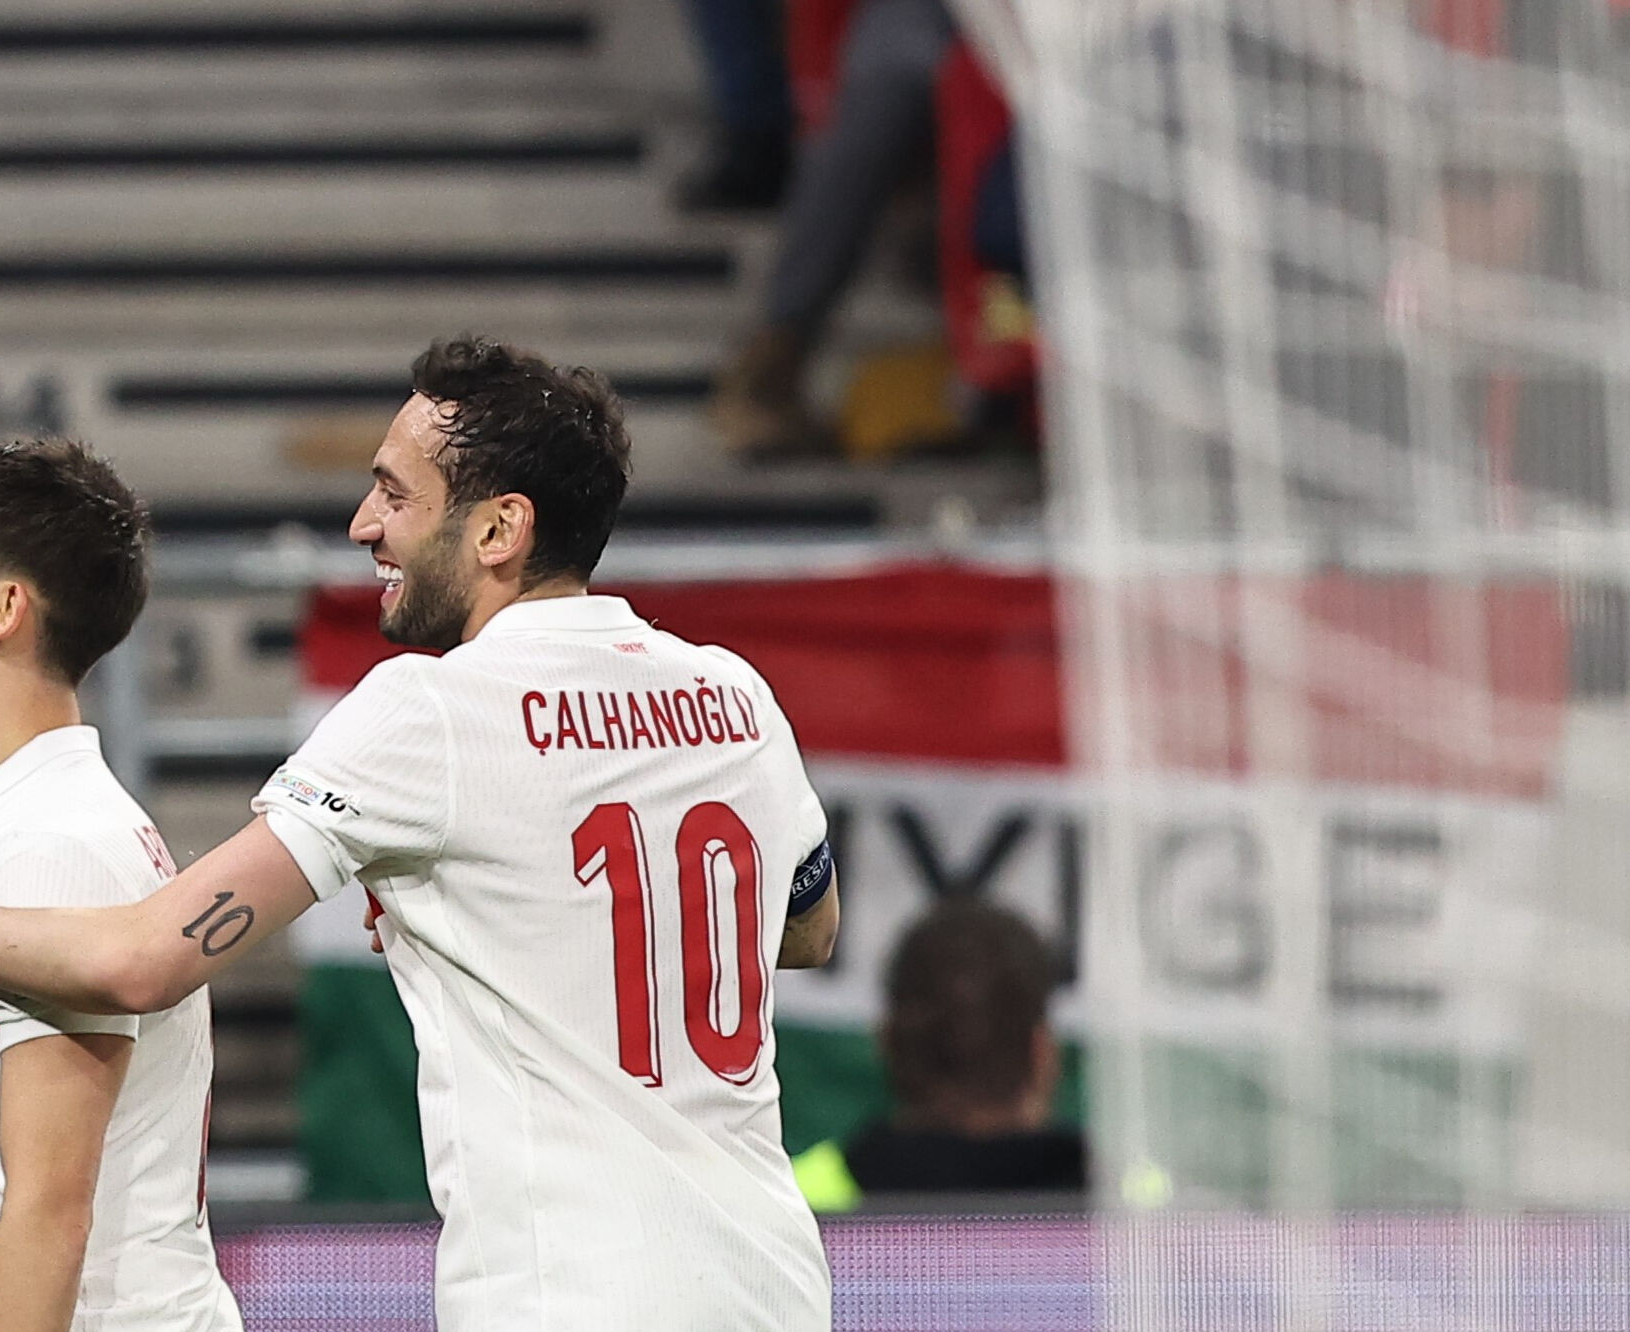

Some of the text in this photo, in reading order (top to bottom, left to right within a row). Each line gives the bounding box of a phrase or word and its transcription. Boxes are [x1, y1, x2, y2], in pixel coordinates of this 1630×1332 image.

[521, 676, 761, 757] ÇALHANOĞLU
[182, 891, 254, 956] 10
[570, 801, 767, 1088] 10
[813, 798, 1447, 1014] YIGE
